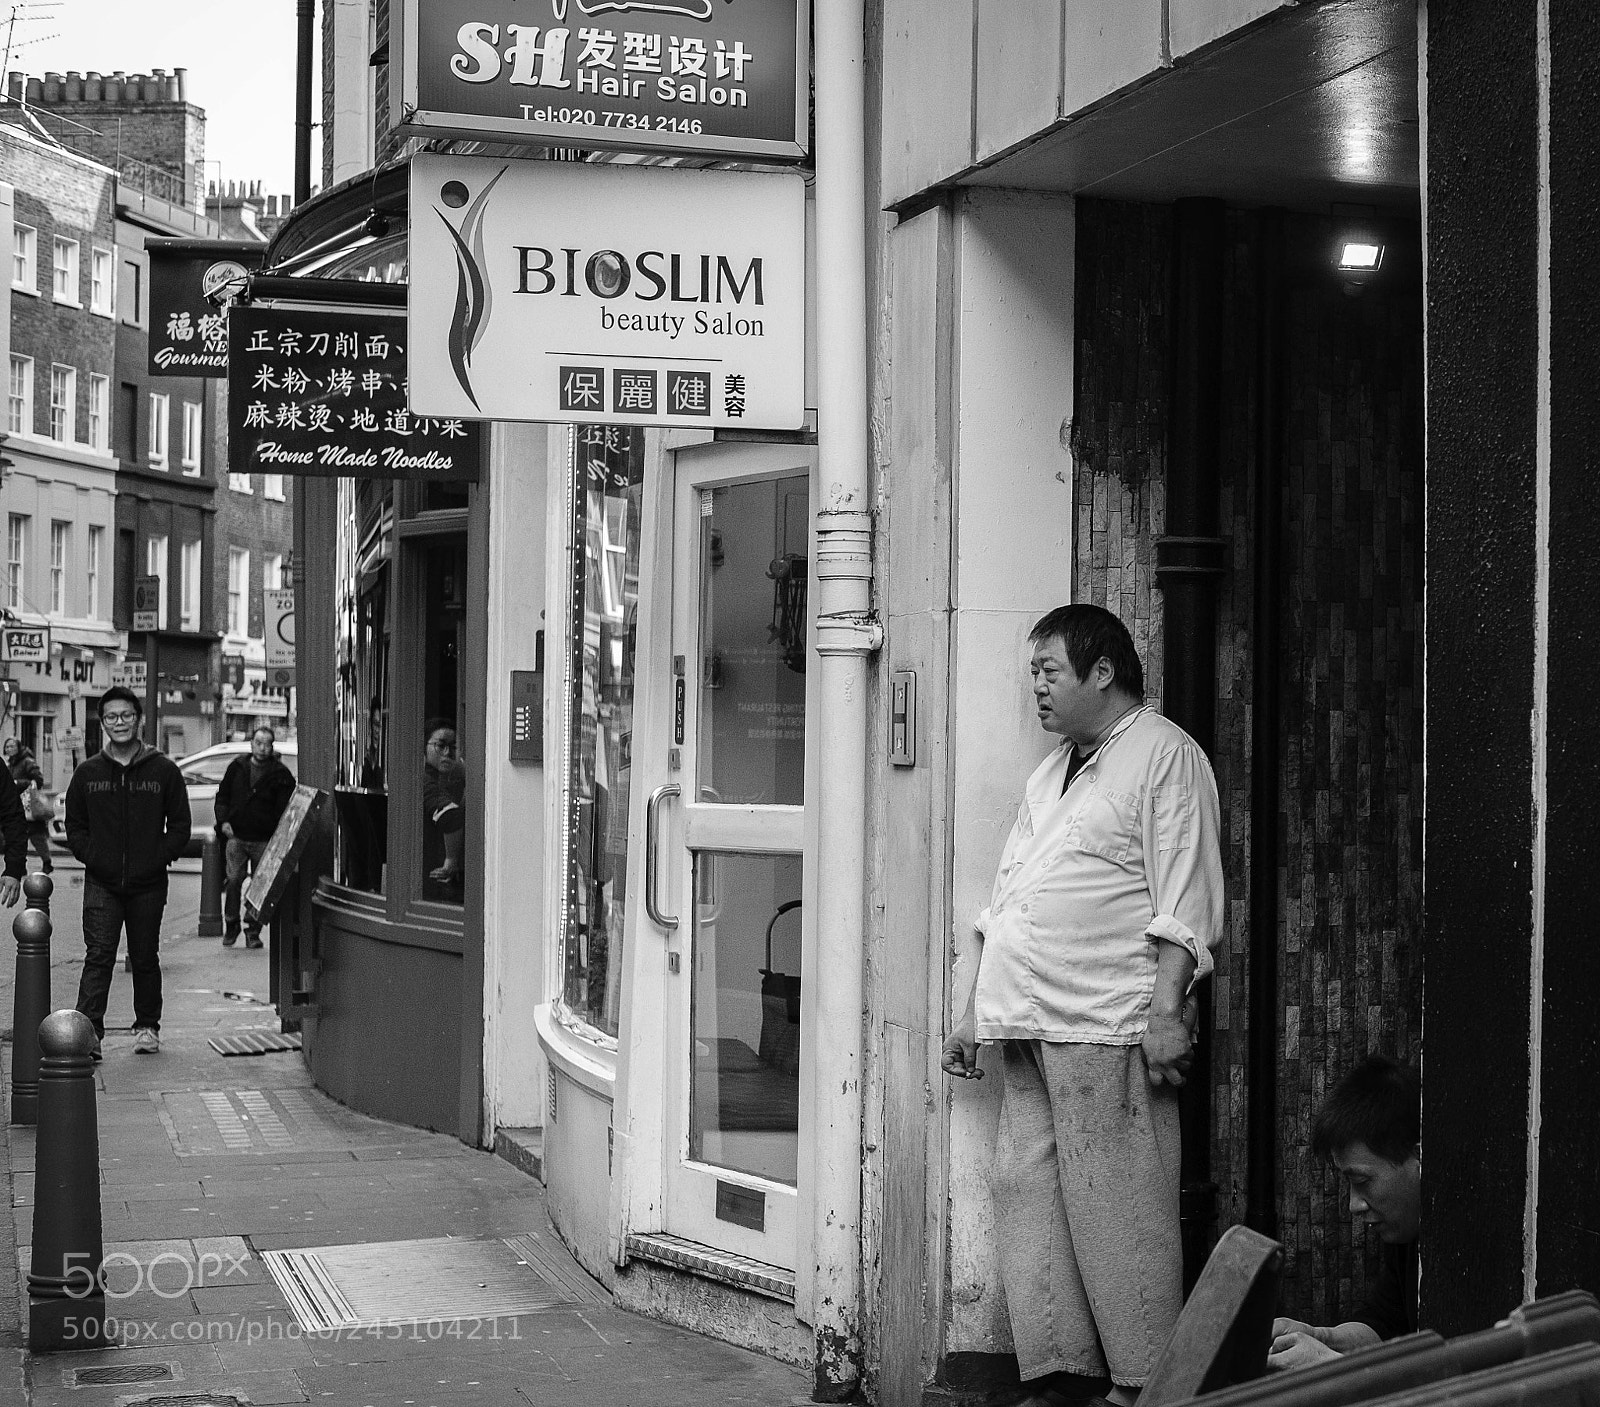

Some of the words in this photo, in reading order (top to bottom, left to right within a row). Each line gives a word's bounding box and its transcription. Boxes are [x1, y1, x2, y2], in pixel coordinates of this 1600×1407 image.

[450, 21, 571, 88] SH
[577, 27, 754, 82] 发型设计
[576, 69, 646, 99] Hair
[656, 76, 748, 107] Salon
[519, 104, 596, 125] Tel:020
[601, 111, 650, 130] 7734
[655, 116, 702, 135] 2146
[512, 245, 765, 305] BIOSLIM
[166, 311, 228, 341] 福榕
[600, 306, 686, 340] beauty
[693, 309, 765, 337] Salon
[251, 363, 408, 399] 米粉、烤串、
[561, 369, 708, 413] 保麗健
[724, 374, 746, 418] 美容
[256, 440, 314, 465] Home
[316, 444, 378, 468] Made
[381, 446, 454, 470] Noodles
